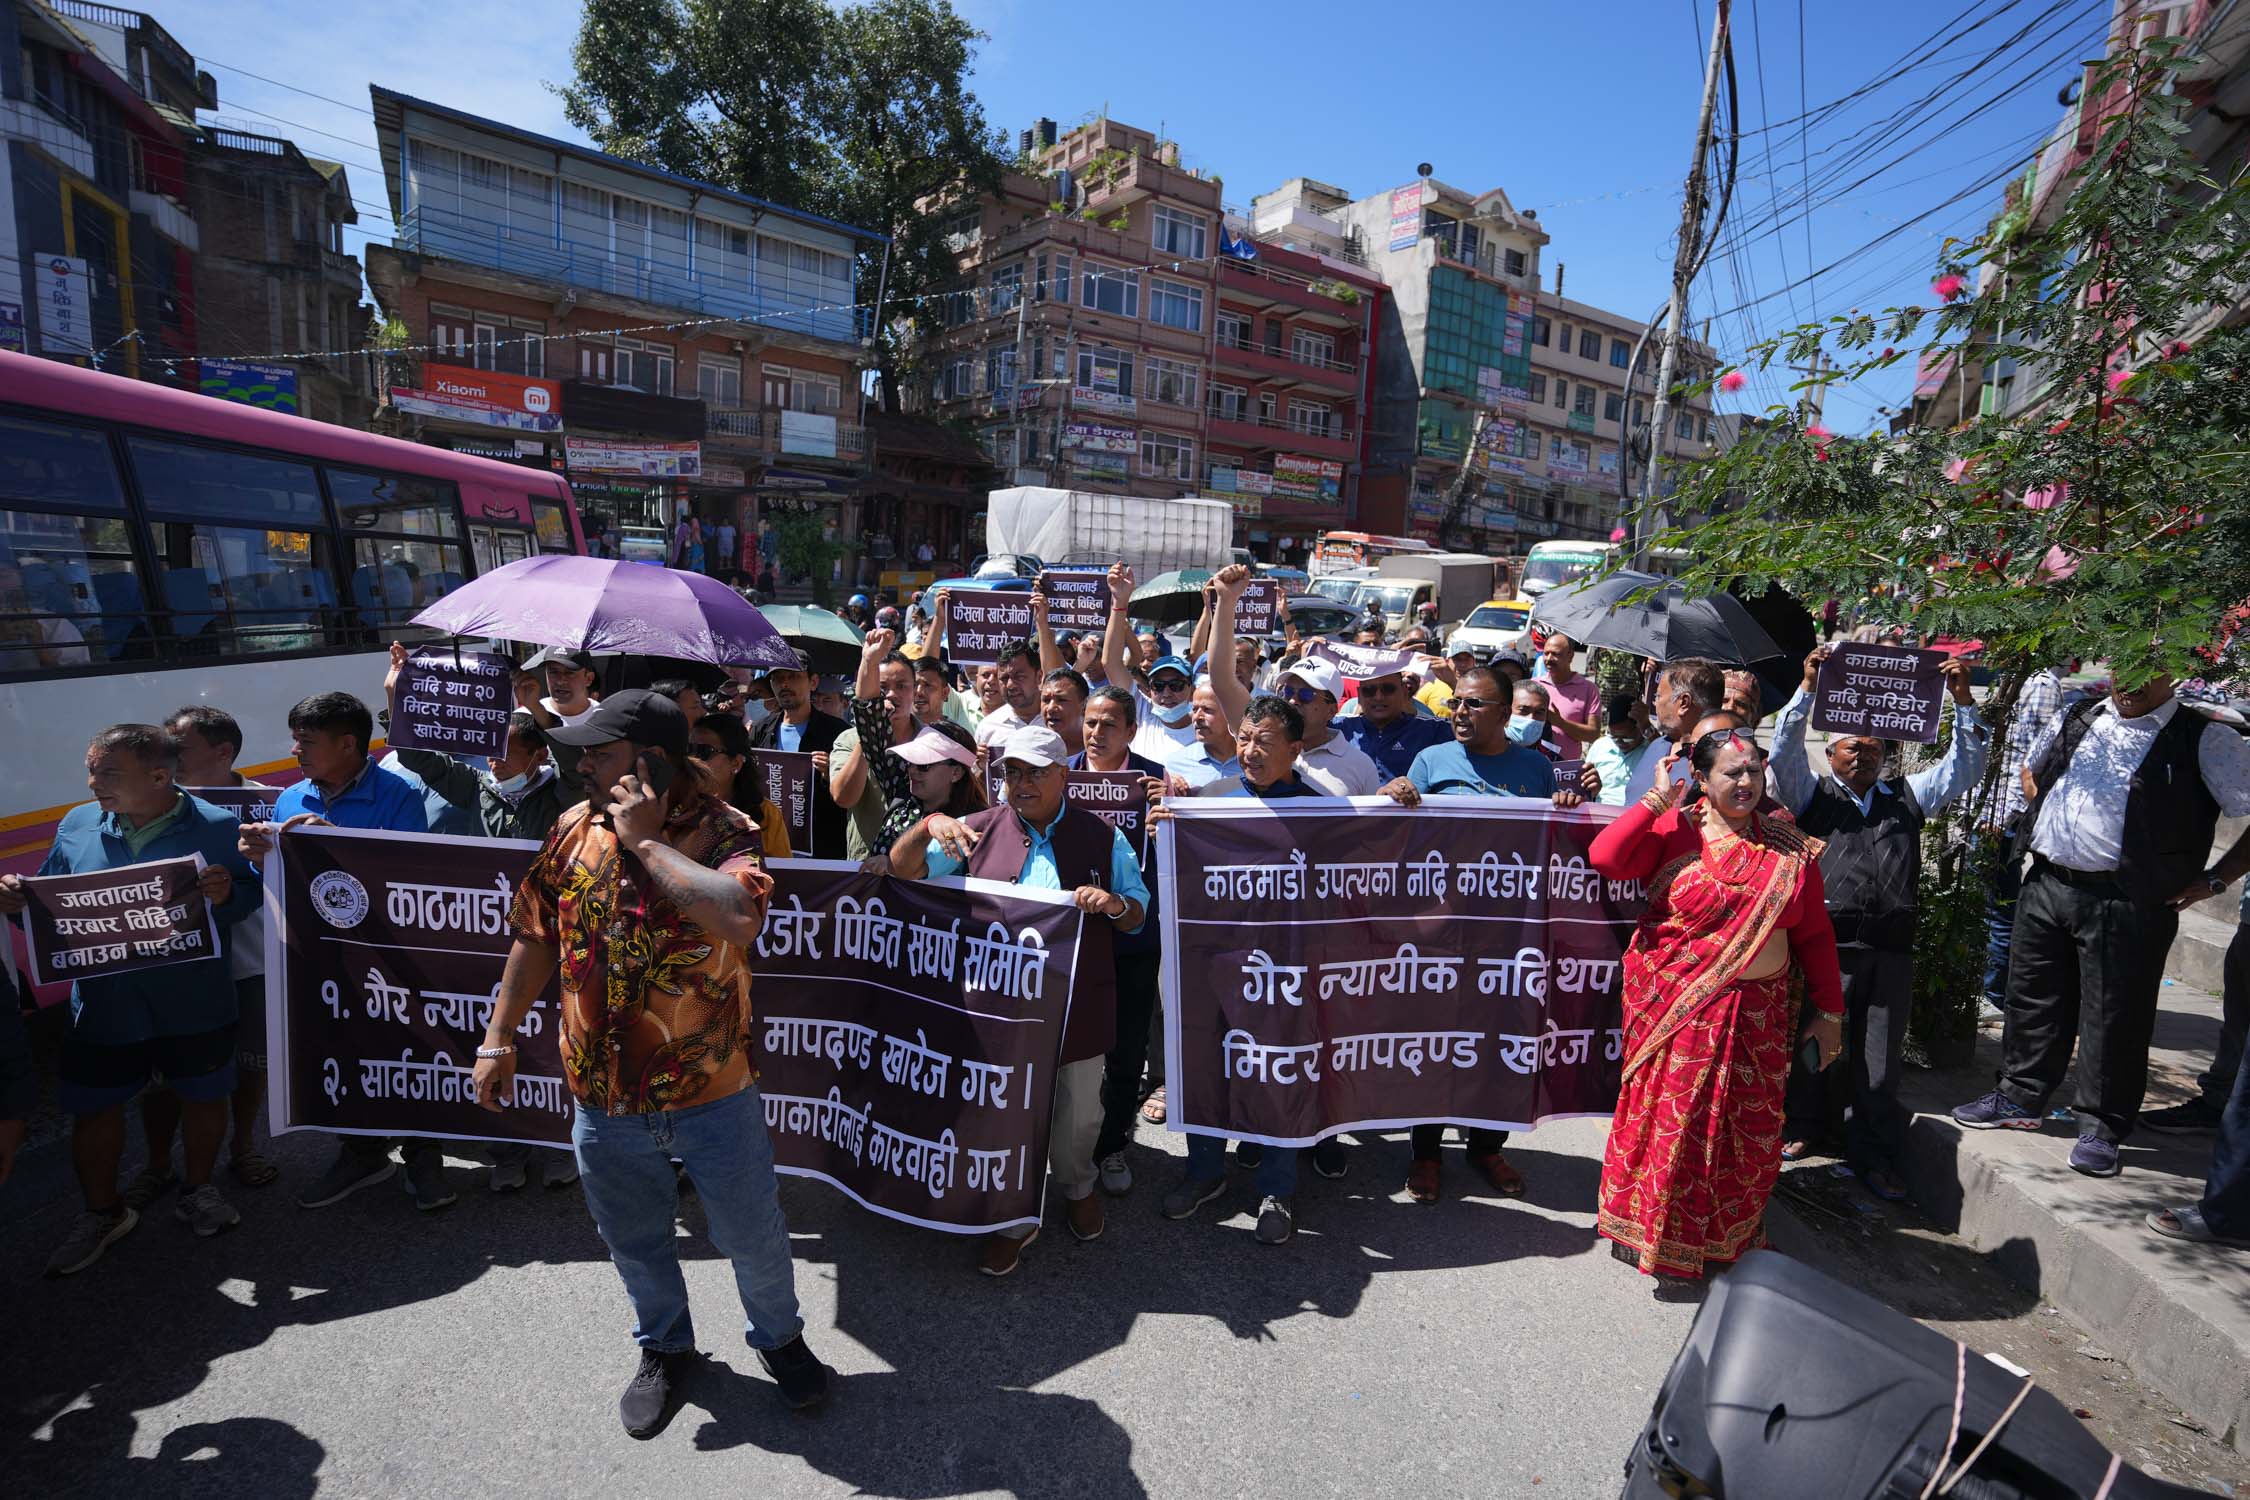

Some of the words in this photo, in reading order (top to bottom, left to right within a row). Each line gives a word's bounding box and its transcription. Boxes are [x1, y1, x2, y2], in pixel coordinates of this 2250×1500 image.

[436, 380, 486, 398] Xiaomi
[1074, 389, 1103, 401] BCC
[1274, 455, 1321, 474] Computer
[1053, 580, 1098, 594] जनतालाई
[953, 600, 985, 623] फैसला
[987, 603, 1031, 625] खारेजीको
[1077, 595, 1104, 610] विहिन
[956, 628, 985, 650] आदेश
[986, 630, 1009, 650] जारी
[416, 651, 437, 671] गैर
[412, 675, 442, 696] नदि
[446, 681, 471, 696] थप
[475, 685, 496, 702] २०
[1846, 672, 1917, 692] उपत्यका
[403, 695, 442, 716] मिटर
[446, 704, 508, 724] मापदण्ड
[1828, 688, 1861, 708] नदि
[1865, 693, 1930, 713] करिडोर
[1825, 706, 1868, 725] संघर्ष
[1870, 712, 1927, 733] समिति
[413, 721, 459, 741] खारेज
[463, 729, 487, 744] गर
[1067, 778, 1129, 802] न्यायीक
[1314, 861, 1399, 900] उपत्यका
[1405, 850, 1449, 905] नदि
[1456, 850, 1541, 900] करिडोर
[1547, 853, 1600, 903] पिडित
[56, 875, 164, 908] जनतालाई
[55, 916, 122, 936] घरबार
[124, 904, 188, 932] विहिन
[51, 943, 128, 969] बनाउन
[834, 895, 903, 970] पिडित
[907, 914, 961, 983] संघर्ष
[963, 921, 1050, 1001] समिति
[1241, 949, 1308, 1006] गैर
[1319, 942, 1464, 1000] न्यायीक
[1477, 946, 1550, 1007] नदि
[1557, 957, 1619, 994] थप
[320, 979, 350, 1020] १.
[364, 967, 410, 1025] गैर
[763, 1015, 878, 1071] मापदण्ड
[882, 1028, 953, 1099] खारेज
[961, 1058, 1014, 1110] गर
[1222, 1029, 1323, 1086] मिटर
[1331, 1032, 1485, 1077] मापदण्ड
[1500, 1018, 1595, 1075] खारेज
[323, 1057, 348, 1107] २.
[868, 1120, 959, 1199] कारवाही
[968, 1148, 1011, 1192] गर
